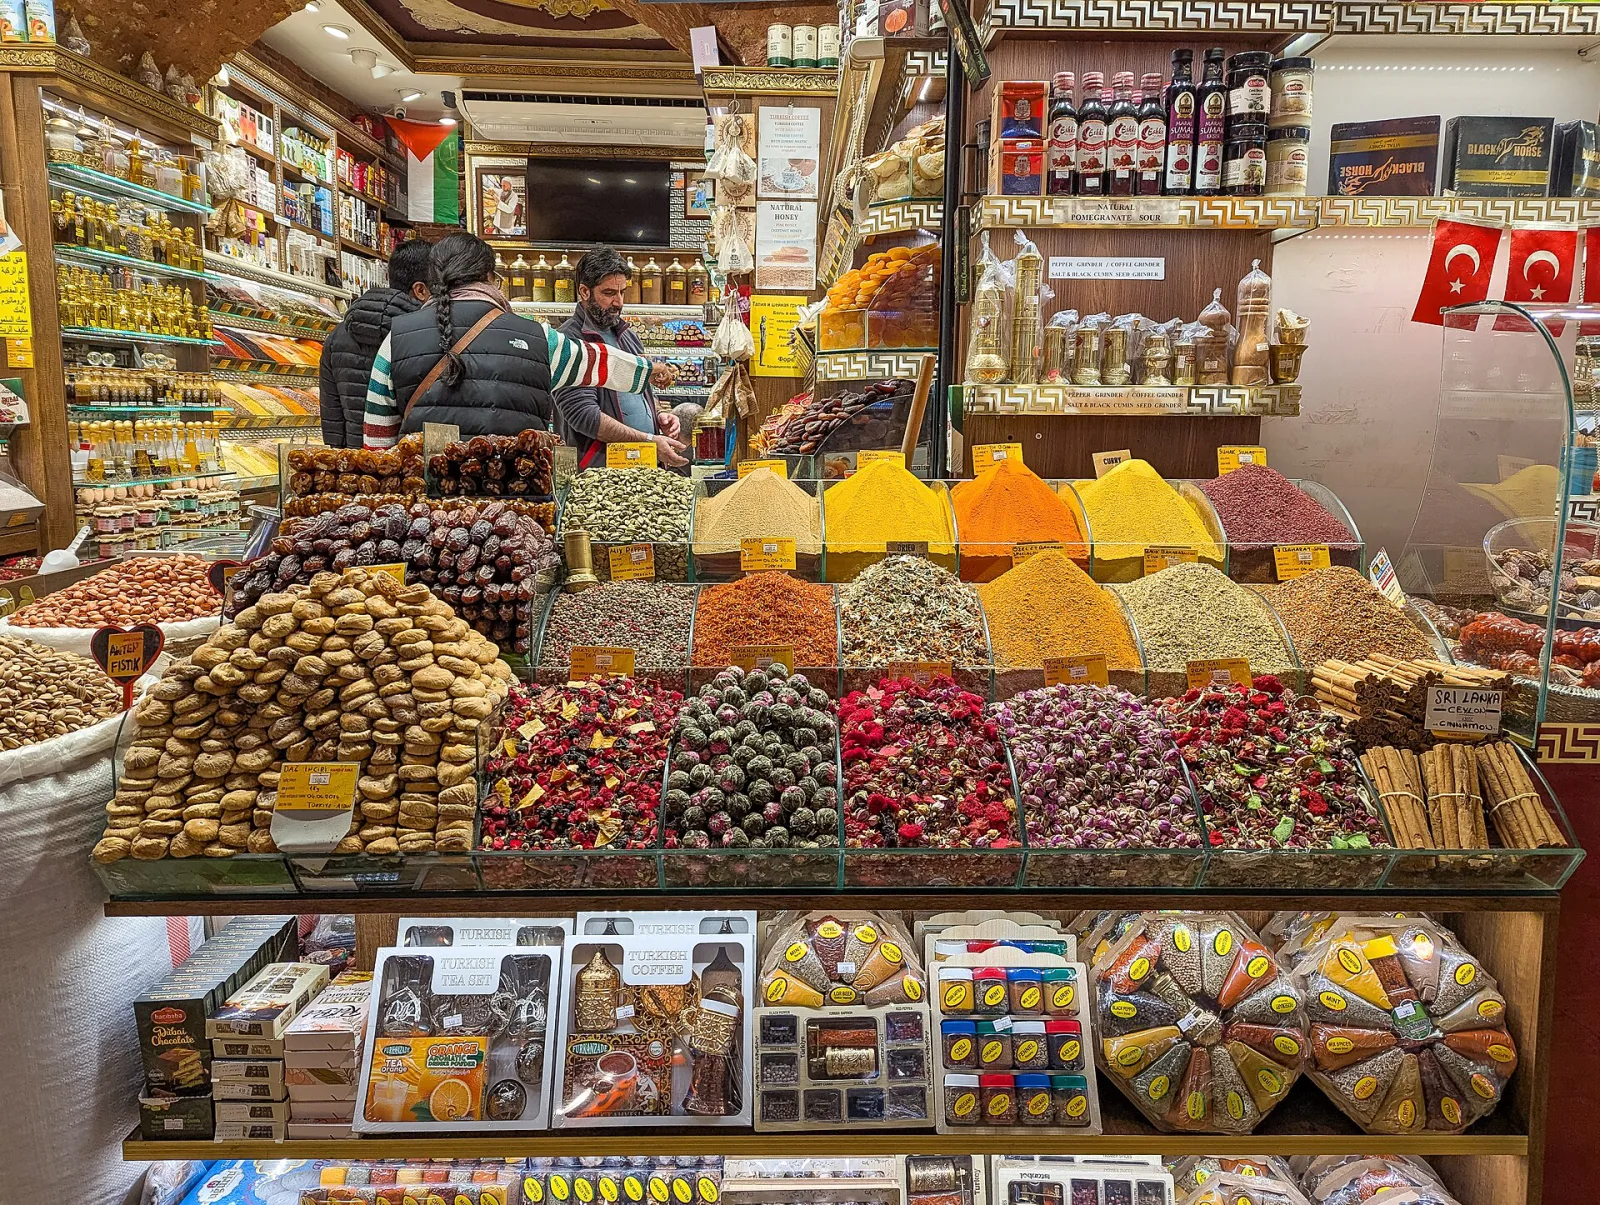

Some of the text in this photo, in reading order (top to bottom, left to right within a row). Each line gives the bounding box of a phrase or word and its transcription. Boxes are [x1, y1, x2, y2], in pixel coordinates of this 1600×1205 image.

[1468, 144, 1542, 157] BLACK HORSE
[1340, 162, 1425, 177] BLACK HORSE
[111, 659, 141, 672] FISTIK
[1435, 691, 1500, 704] SRI LANKA
[460, 929, 512, 940] TURKISH
[638, 924, 694, 935] TURKISH
[629, 951, 687, 961] TURKISH
[790, 946, 802, 957] MINT
[441, 958, 495, 969] TURKISH
[632, 964, 684, 975] COFFEE
[441, 975, 492, 986] TEA SET
[989, 989, 1001, 1000] MINT
[1027, 989, 1038, 999] SPICES
[1055, 989, 1071, 1003] CURRY
[1326, 996, 1341, 1004] MINT
[153, 1026, 187, 1037] Dubai
[151, 1035, 195, 1046] Chocolate
[1278, 1041, 1292, 1050] CHILI
[430, 1044, 478, 1055] ORANGE
[954, 1042, 966, 1054] CHILI
[983, 1043, 1000, 1059] CORIANDER
[1018, 1043, 1035, 1057] FENNEL
[1152, 1081, 1164, 1092] MINT
[1356, 1080, 1373, 1095] FENNEL
[957, 1096, 972, 1112] OREGANO
[1069, 1100, 1084, 1112] CUMIN
[1444, 1104, 1454, 1117] CHILI
[602, 1179, 610, 1192] LEMON
[652, 1180, 662, 1193] ORANGE
